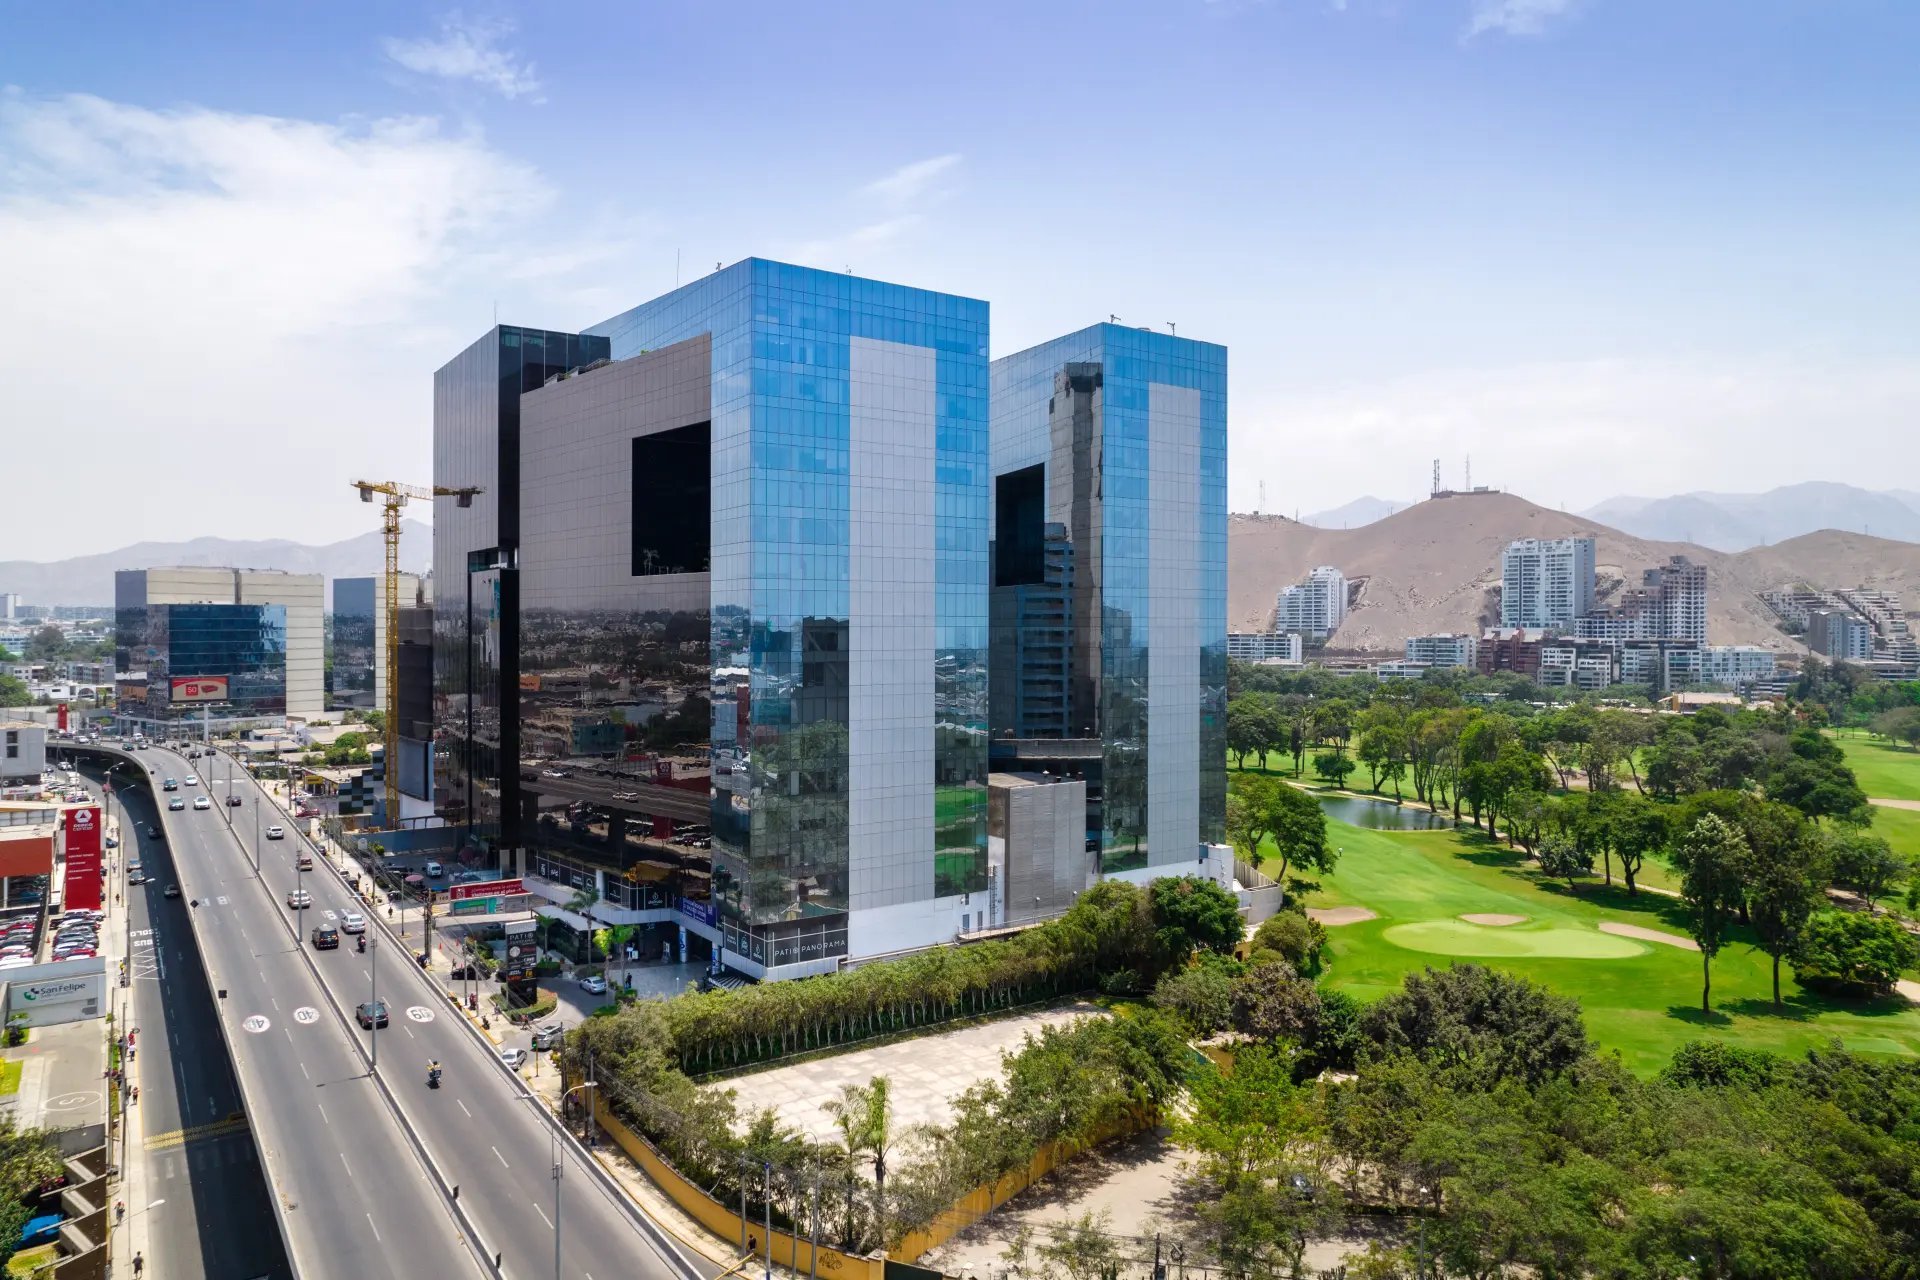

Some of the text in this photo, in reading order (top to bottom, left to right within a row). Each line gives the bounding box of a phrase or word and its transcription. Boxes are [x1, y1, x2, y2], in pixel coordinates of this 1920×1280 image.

[801, 939, 846, 952] PANORAMA
[40, 983, 86, 994] San Felipe
